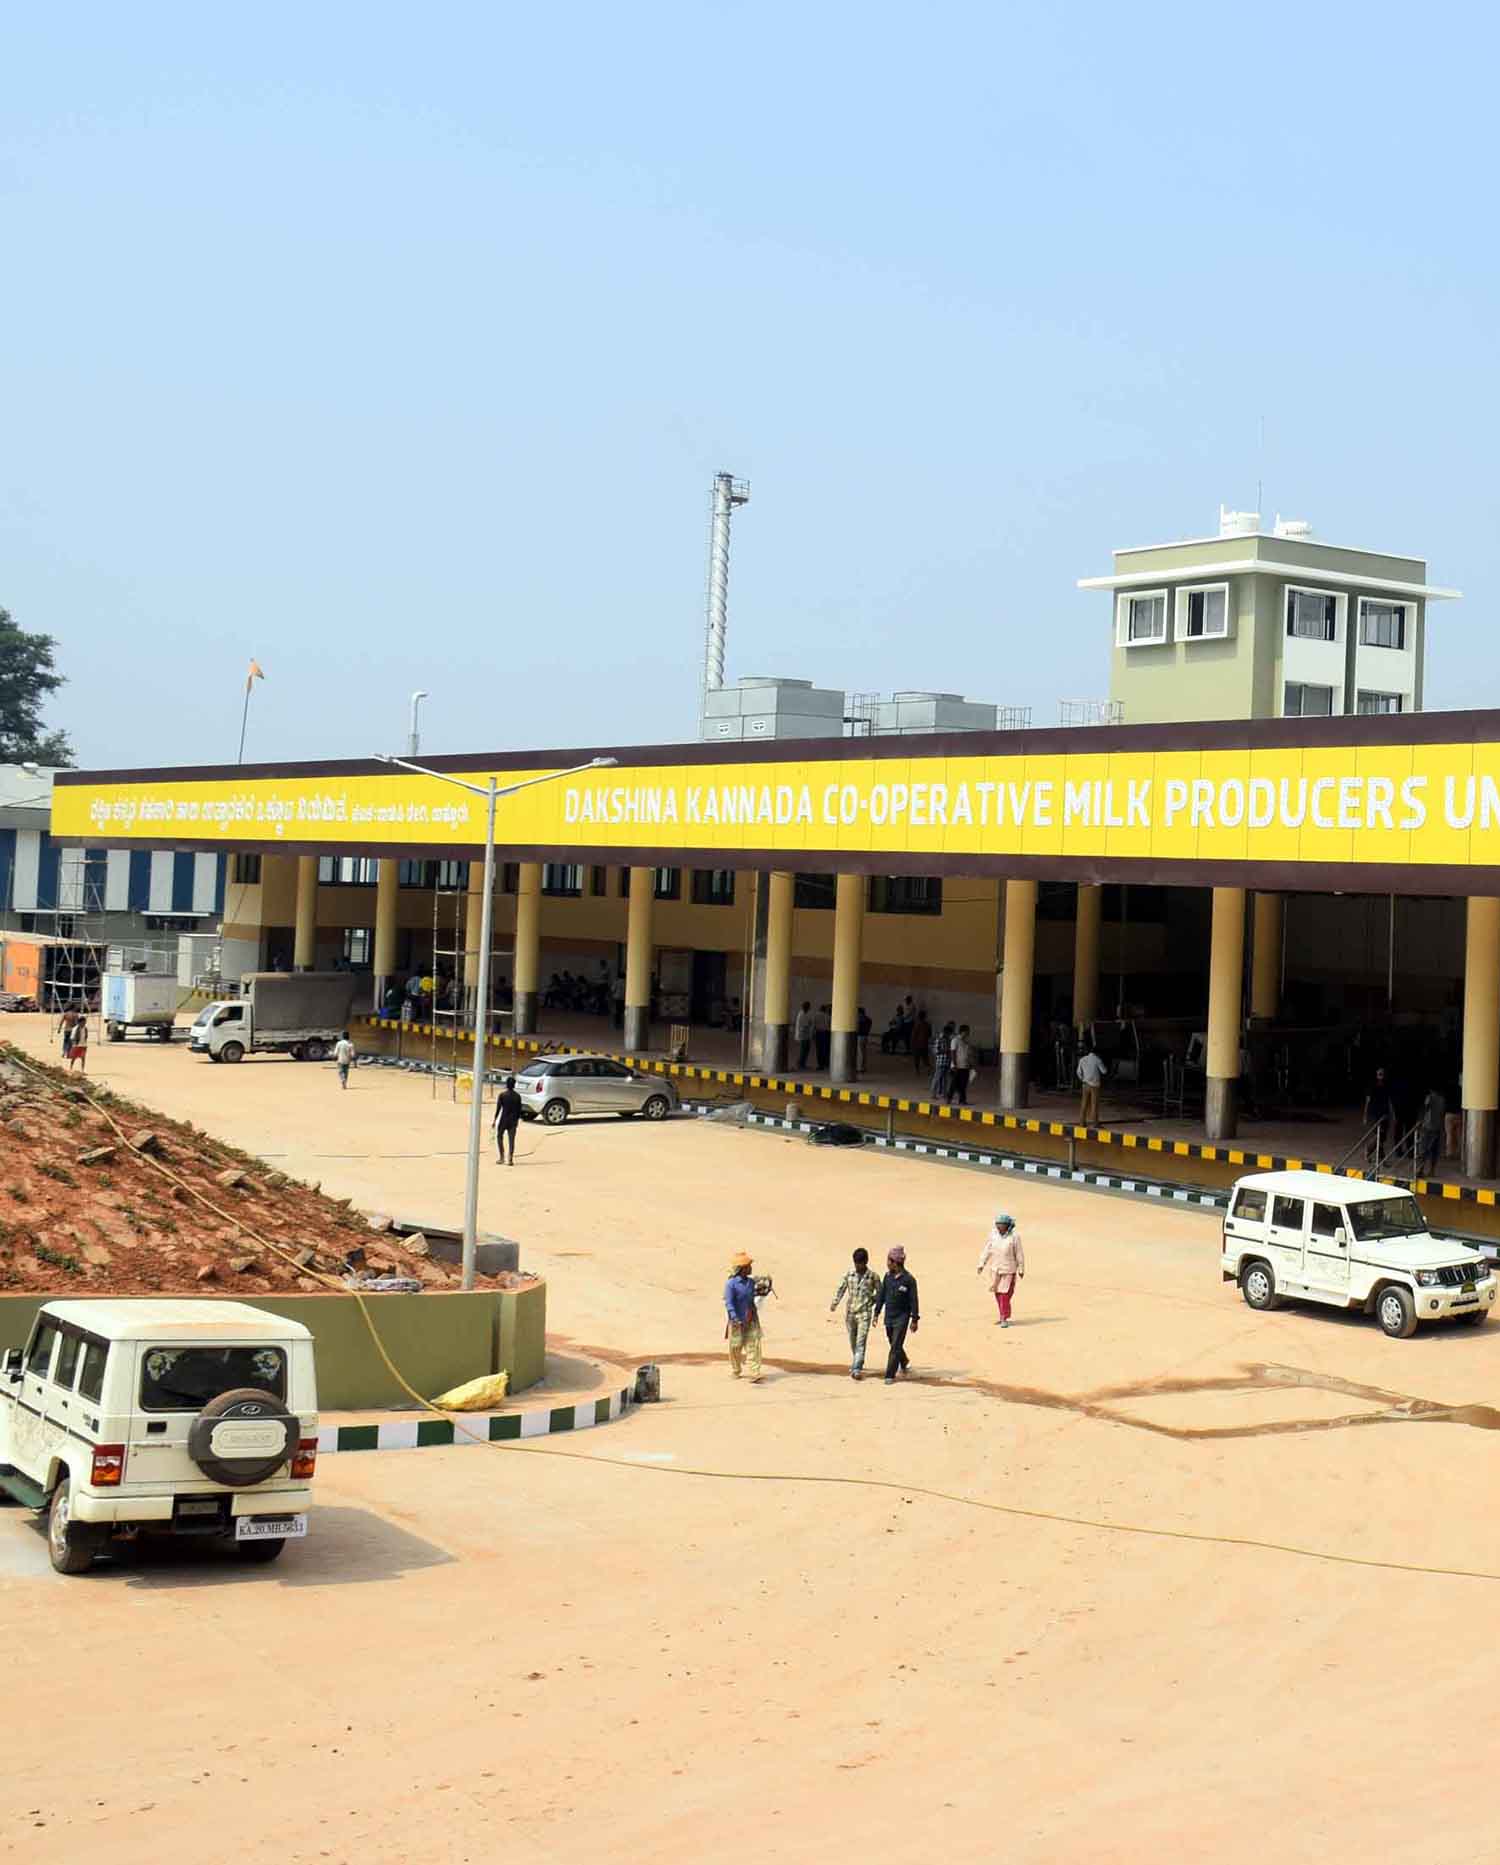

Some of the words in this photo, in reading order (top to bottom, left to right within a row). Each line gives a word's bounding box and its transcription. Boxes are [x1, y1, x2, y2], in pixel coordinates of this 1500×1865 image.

[564, 788, 678, 824] DAKSHINA
[686, 785, 813, 825] KANNADA
[824, 781, 1053, 826] CO-OPERATIVE
[1064, 780, 1152, 827] MILK
[1165, 776, 1427, 829] PRODUCERS
